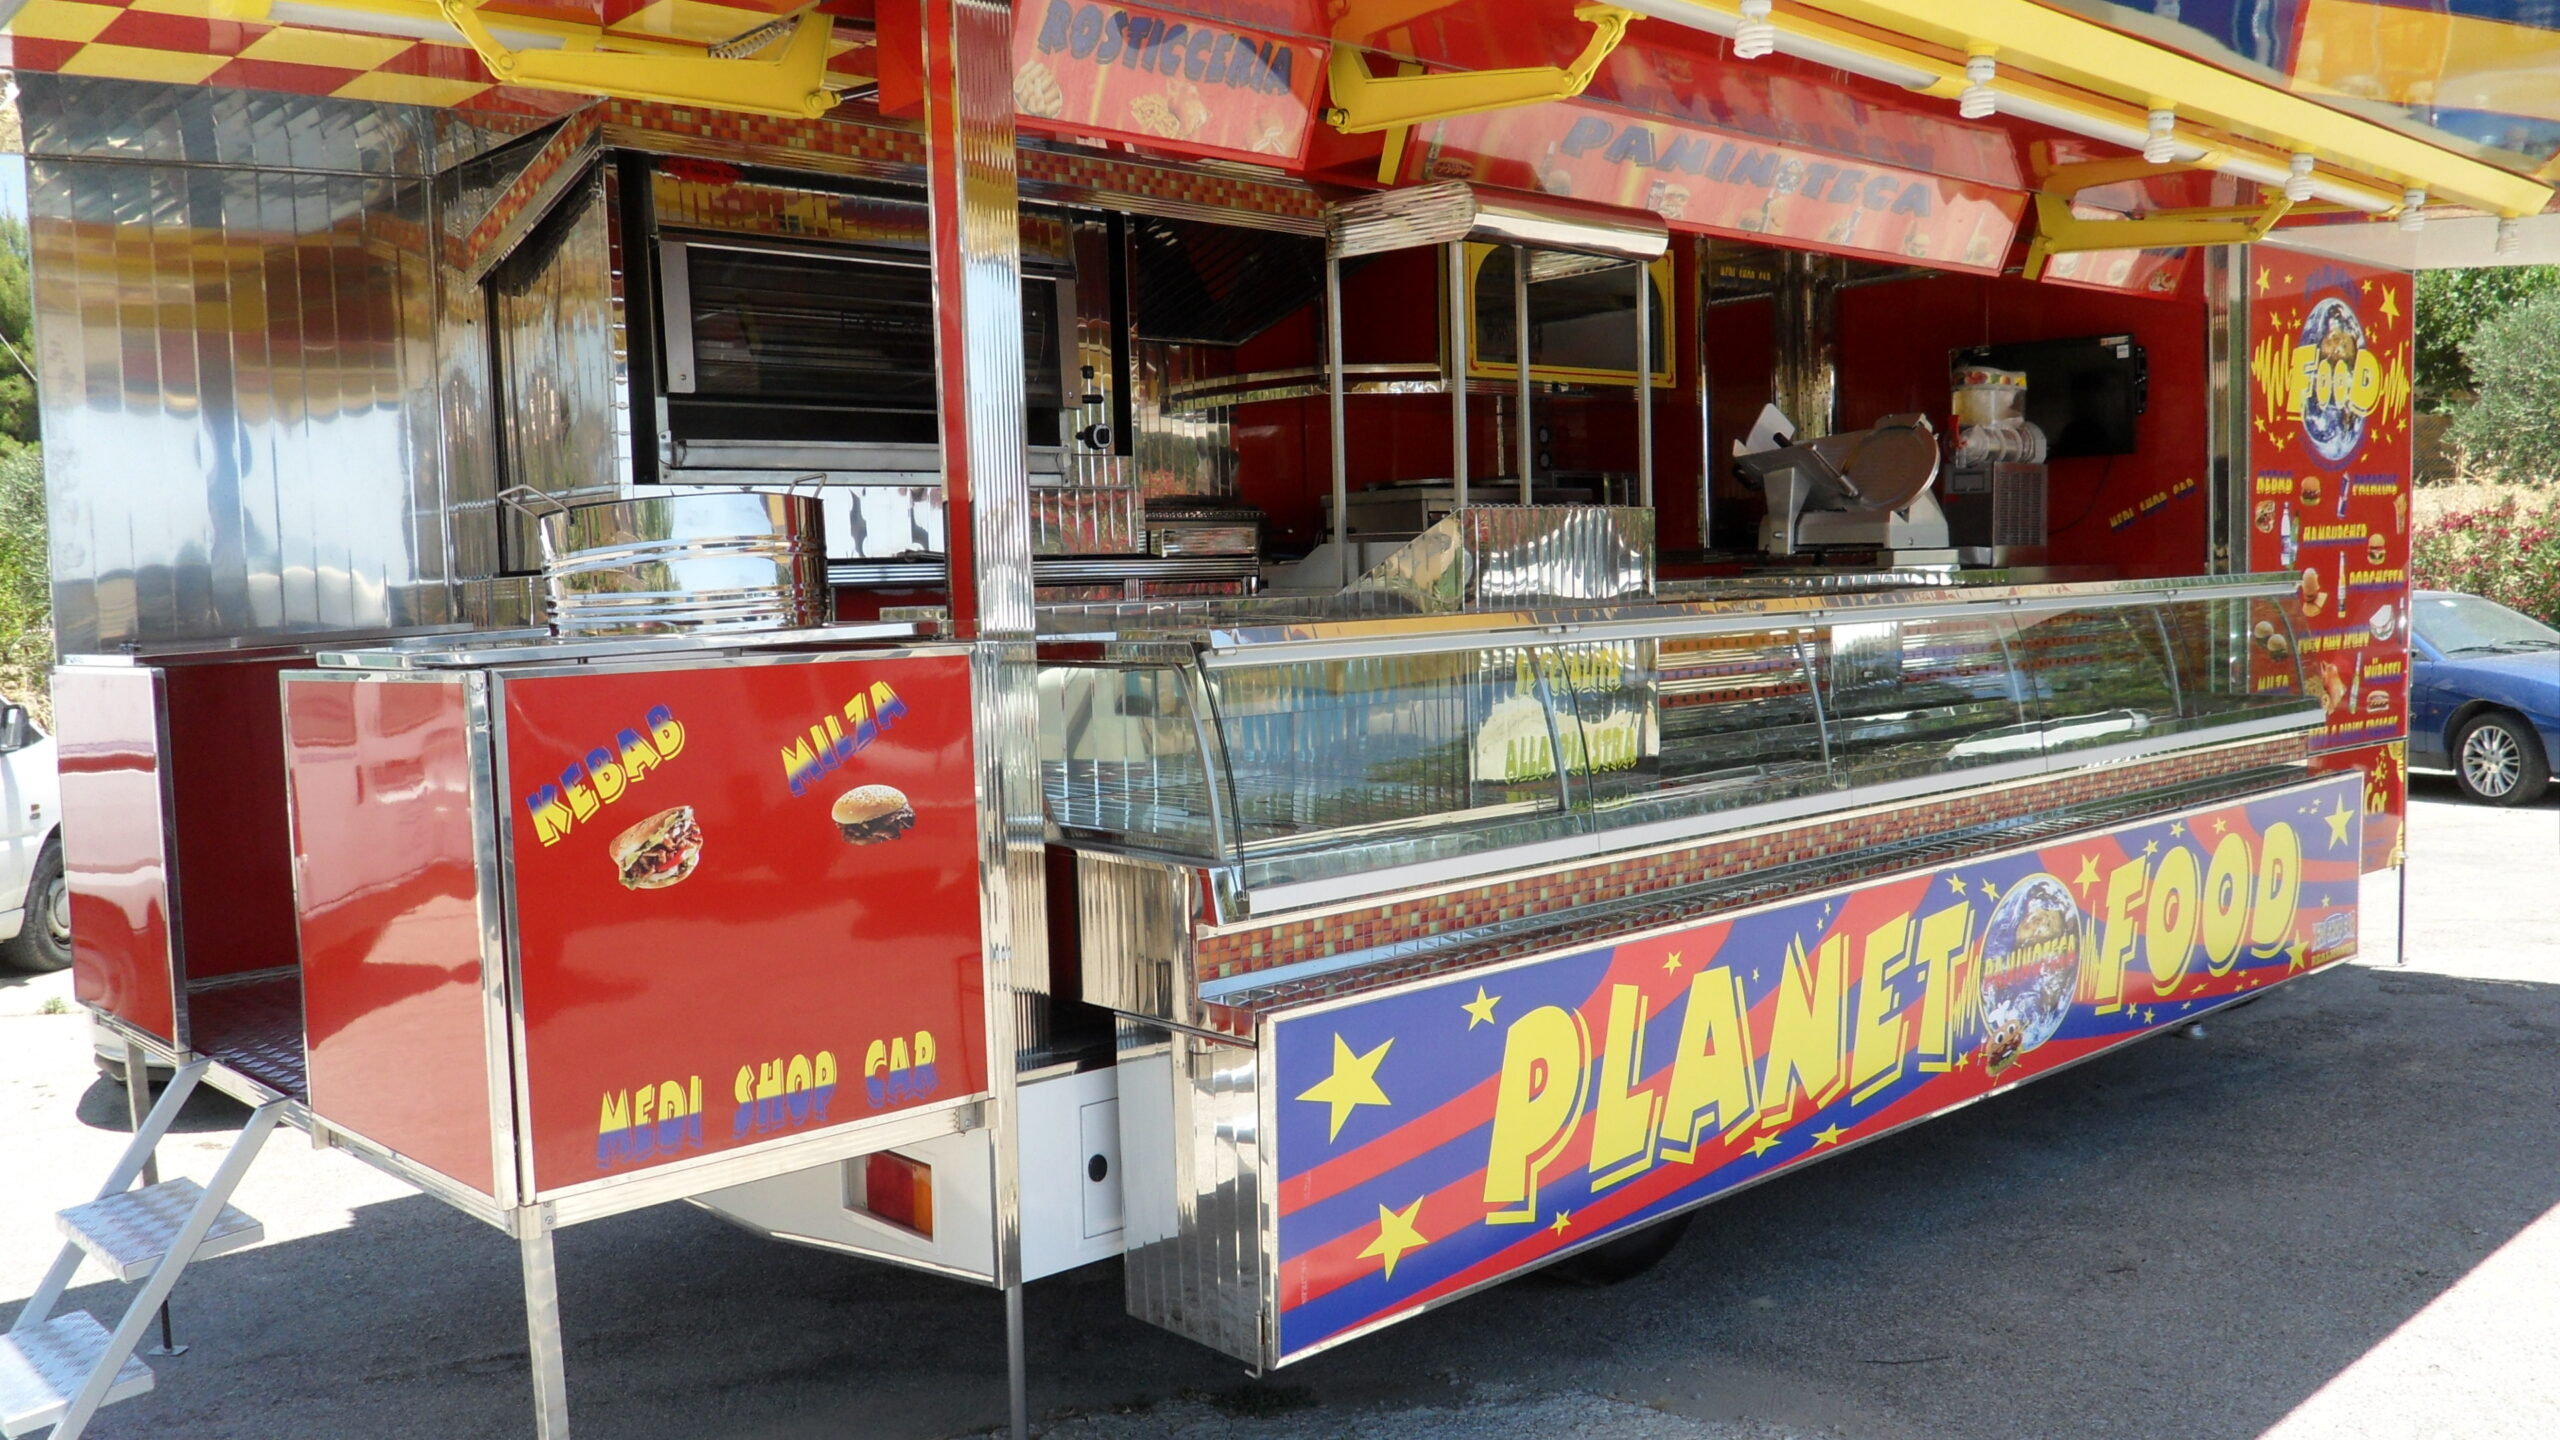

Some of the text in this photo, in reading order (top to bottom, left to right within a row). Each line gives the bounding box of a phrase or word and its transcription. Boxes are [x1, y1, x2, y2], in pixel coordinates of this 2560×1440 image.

[1037, 0, 1293, 96] ROSTICCERIA
[2286, 343, 2382, 421] FOOD
[526, 704, 685, 847] KEBAB
[781, 681, 908, 797] MILZA
[1504, 727, 1637, 784] ALLA PIASTRA
[1482, 821, 2301, 1225] PLANET FOOD
[597, 1030, 939, 1168] MEDI SHOP CAR
